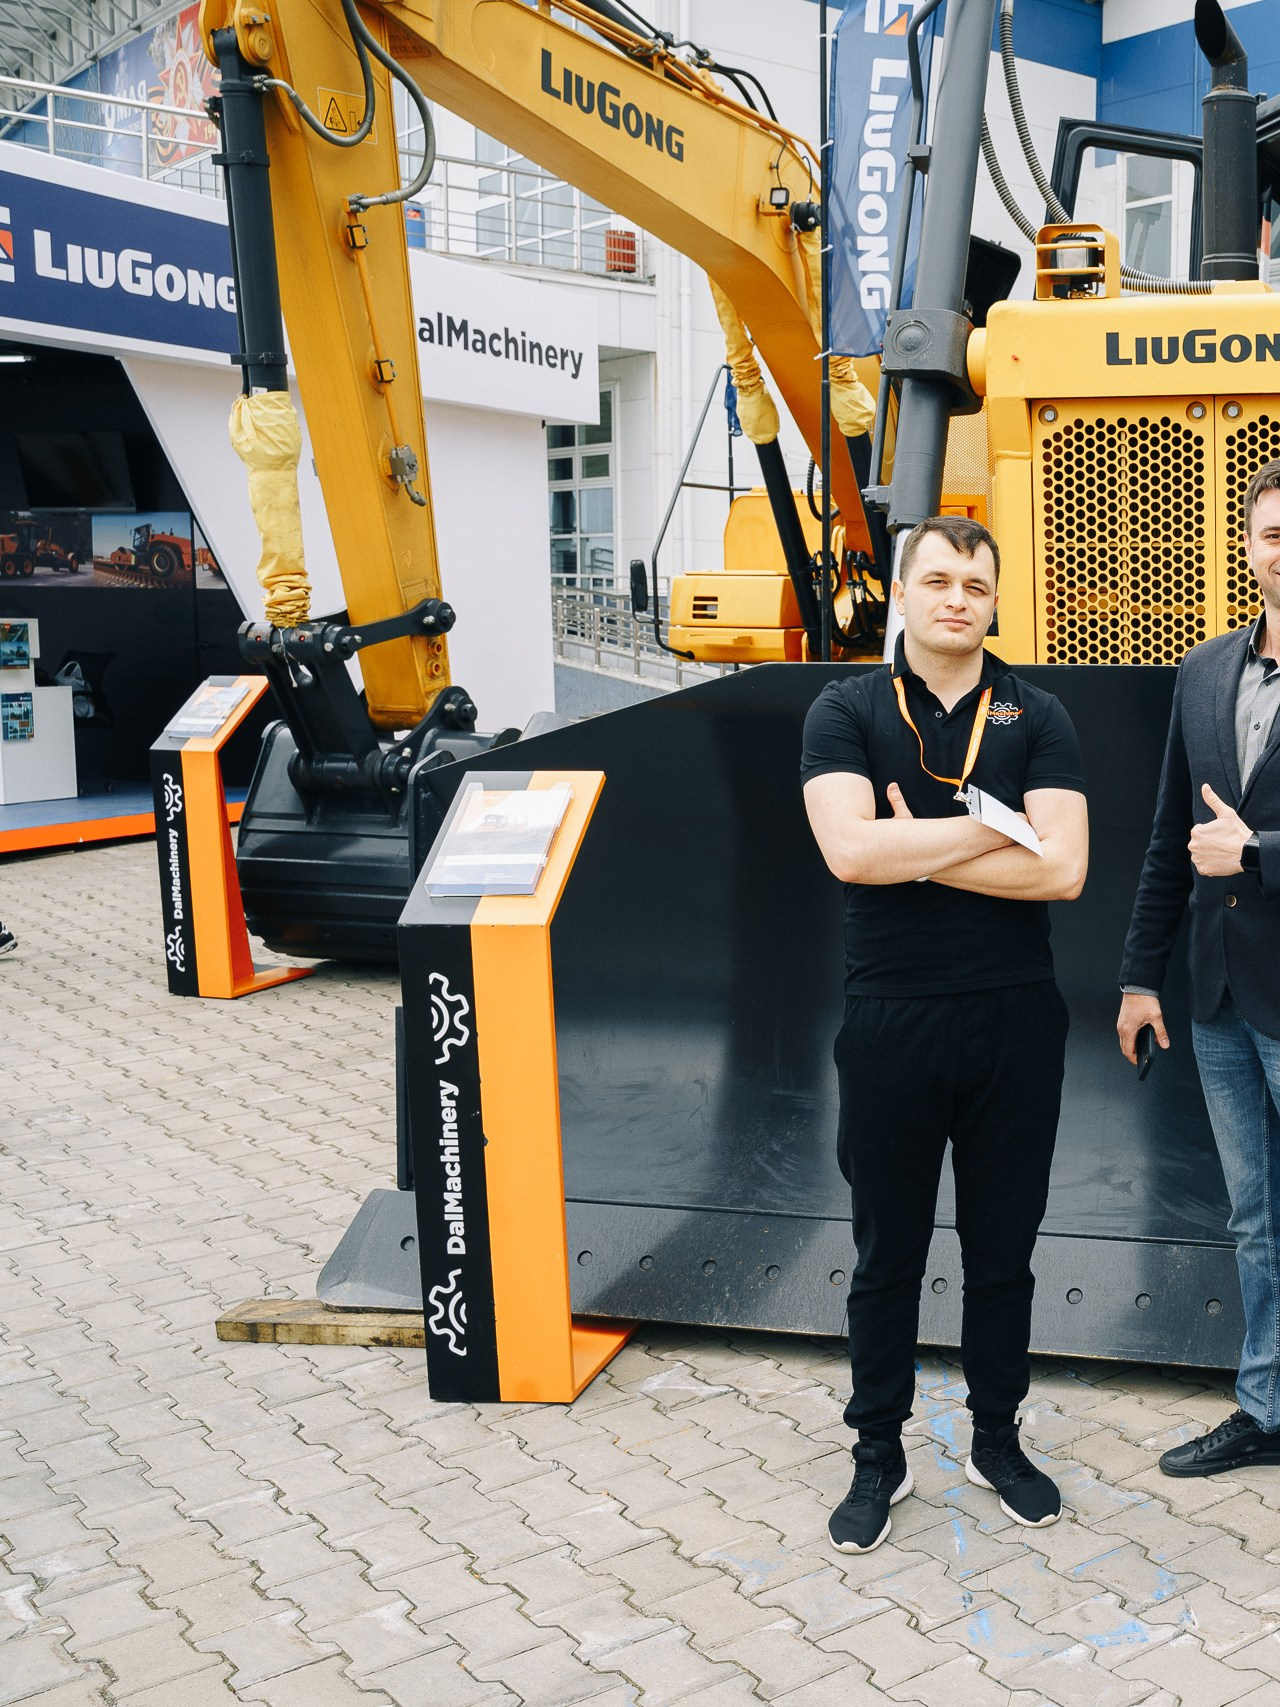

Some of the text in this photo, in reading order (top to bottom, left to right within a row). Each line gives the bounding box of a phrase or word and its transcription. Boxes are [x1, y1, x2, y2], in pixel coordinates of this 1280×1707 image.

[857, 57, 909, 310] LIUGONG
[168, 828, 184, 920] DalMachinery
[439, 1080, 467, 1255] DalMachinery
